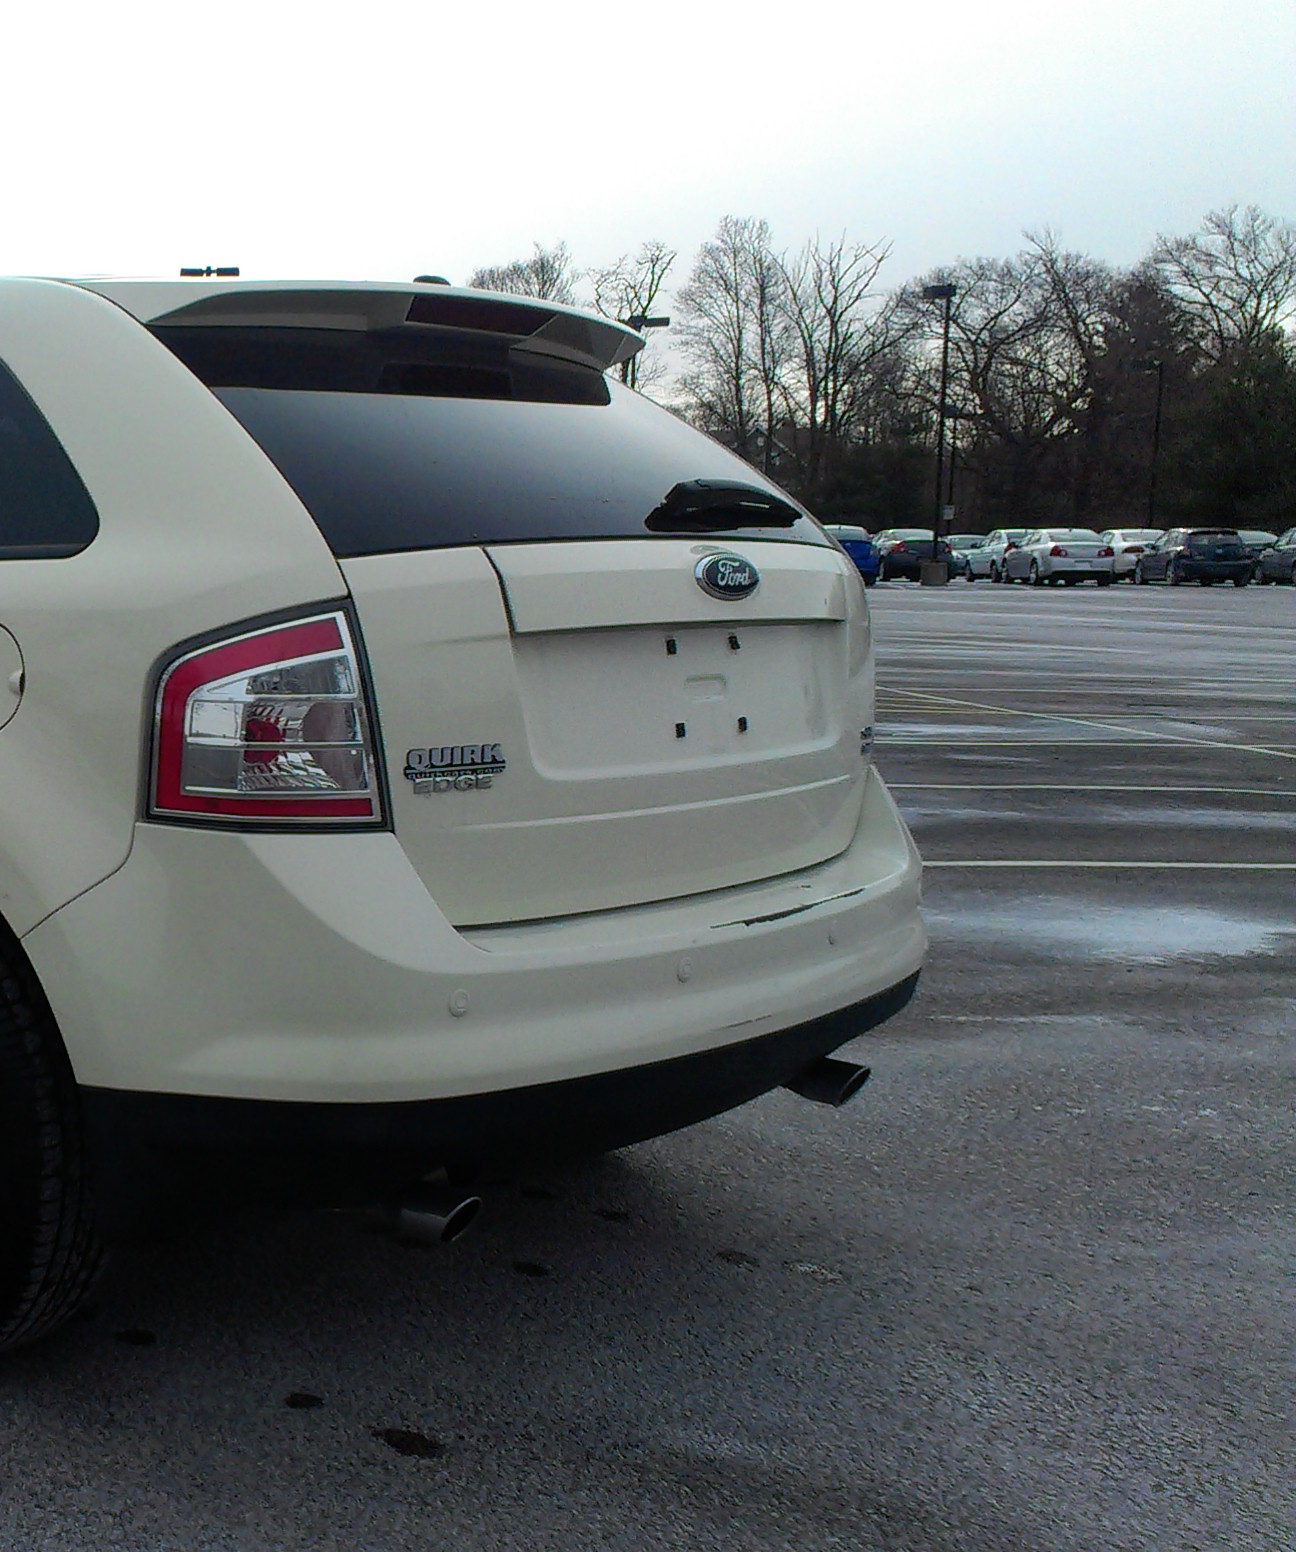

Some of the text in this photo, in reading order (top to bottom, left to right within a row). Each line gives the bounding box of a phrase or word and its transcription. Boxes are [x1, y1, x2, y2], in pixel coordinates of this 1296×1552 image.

[717, 560, 751, 587] Ford
[406, 743, 504, 770] QUIRK
[413, 774, 494, 794] EDGE
